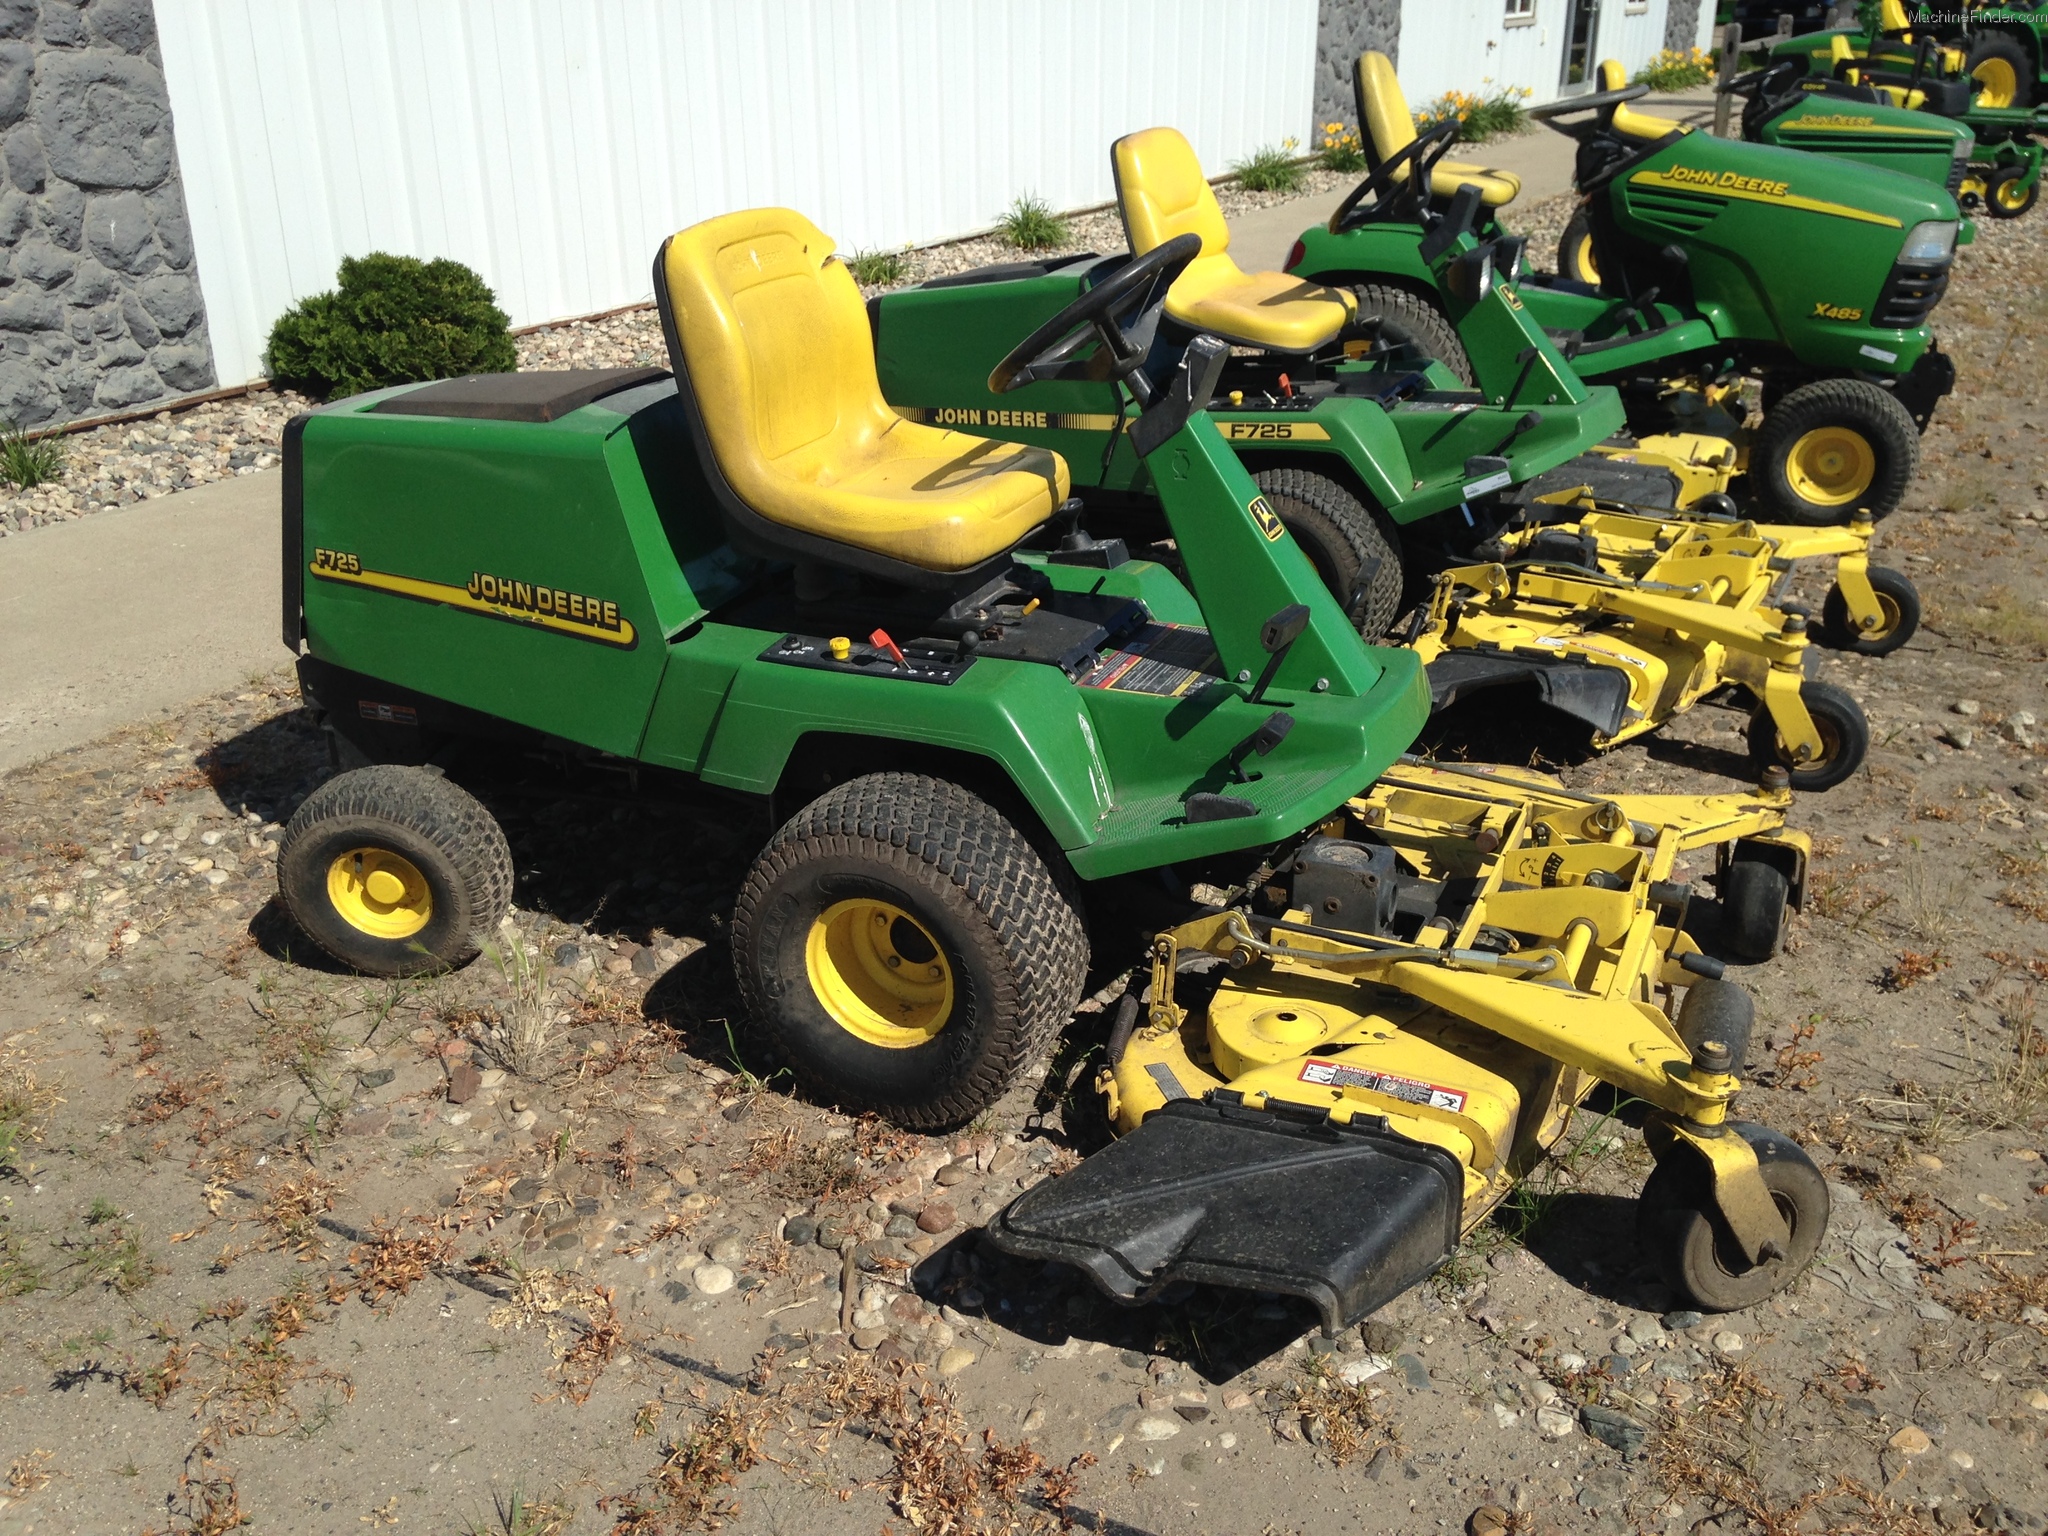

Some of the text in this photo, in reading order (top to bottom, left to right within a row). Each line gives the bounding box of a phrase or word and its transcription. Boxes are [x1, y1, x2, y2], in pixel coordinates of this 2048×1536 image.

[1661, 164, 1789, 197] JOHN DEERE
[1813, 302, 1862, 321] X485
[934, 407, 1047, 428] JOHN DEERE
[1230, 422, 1293, 439] F725
[314, 547, 361, 574] F725
[467, 571, 621, 630] JOHN DEERE
[1341, 1065, 1378, 1077] DANGER
[1392, 1076, 1431, 1089] PELIGRO
